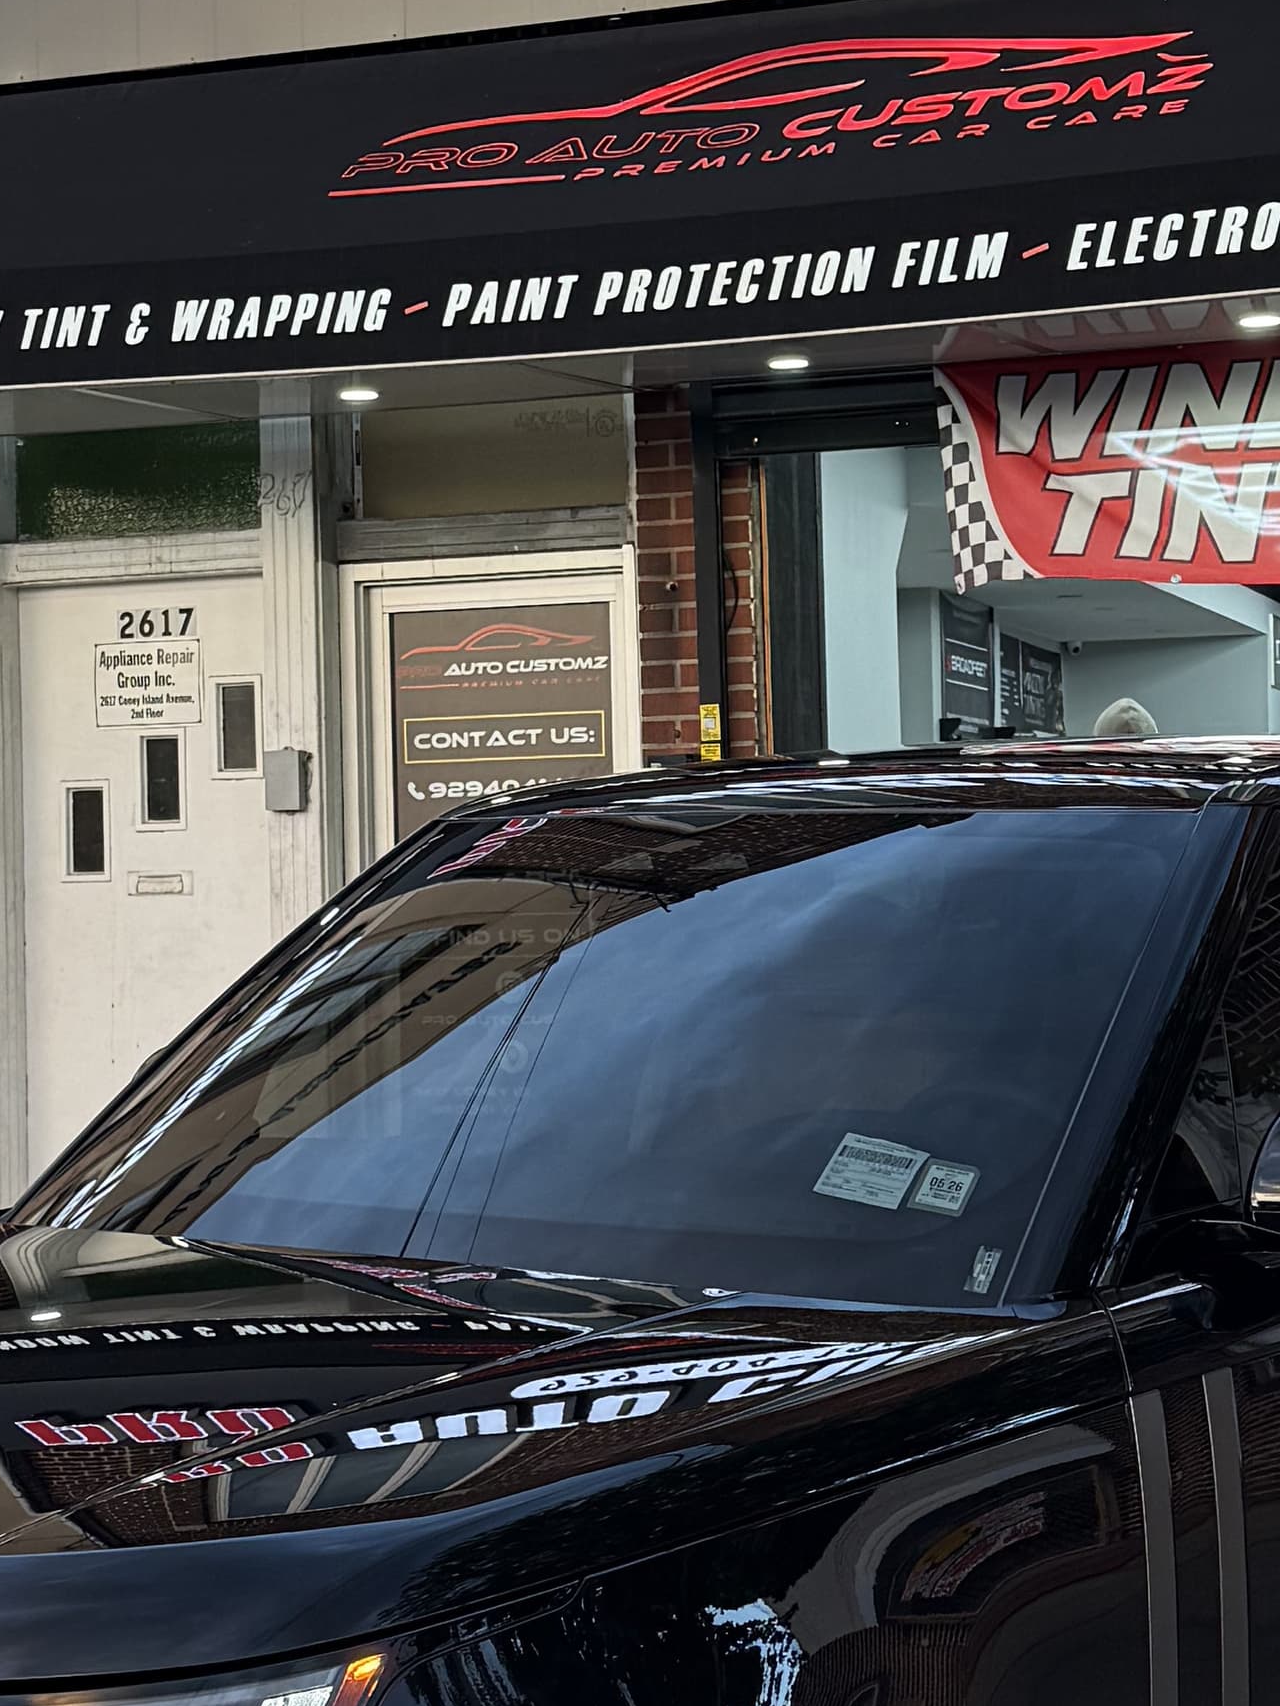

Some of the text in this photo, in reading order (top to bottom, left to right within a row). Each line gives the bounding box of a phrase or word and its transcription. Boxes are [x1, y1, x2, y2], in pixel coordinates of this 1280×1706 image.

[341, 59, 1214, 177] PRO AUTO CUSTOMZ
[573, 98, 1191, 181] PREMIUM CAR CARE
[19, 304, 111, 351] TINT
[124, 302, 151, 346] &
[171, 288, 393, 343] WRAPPING
[441, 274, 579, 327] PAINT
[593, 245, 876, 317] PROTECTION
[891, 231, 1009, 289] FILM
[119, 608, 194, 639] 2617
[99, 647, 195, 671] Appliance Repair
[444, 659, 503, 676] AUTO
[506, 656, 609, 674] CUSTOMZ
[117, 670, 175, 690] Group Inc.
[100, 695, 116, 706] 2617
[414, 726, 595, 749] CONTACT US:
